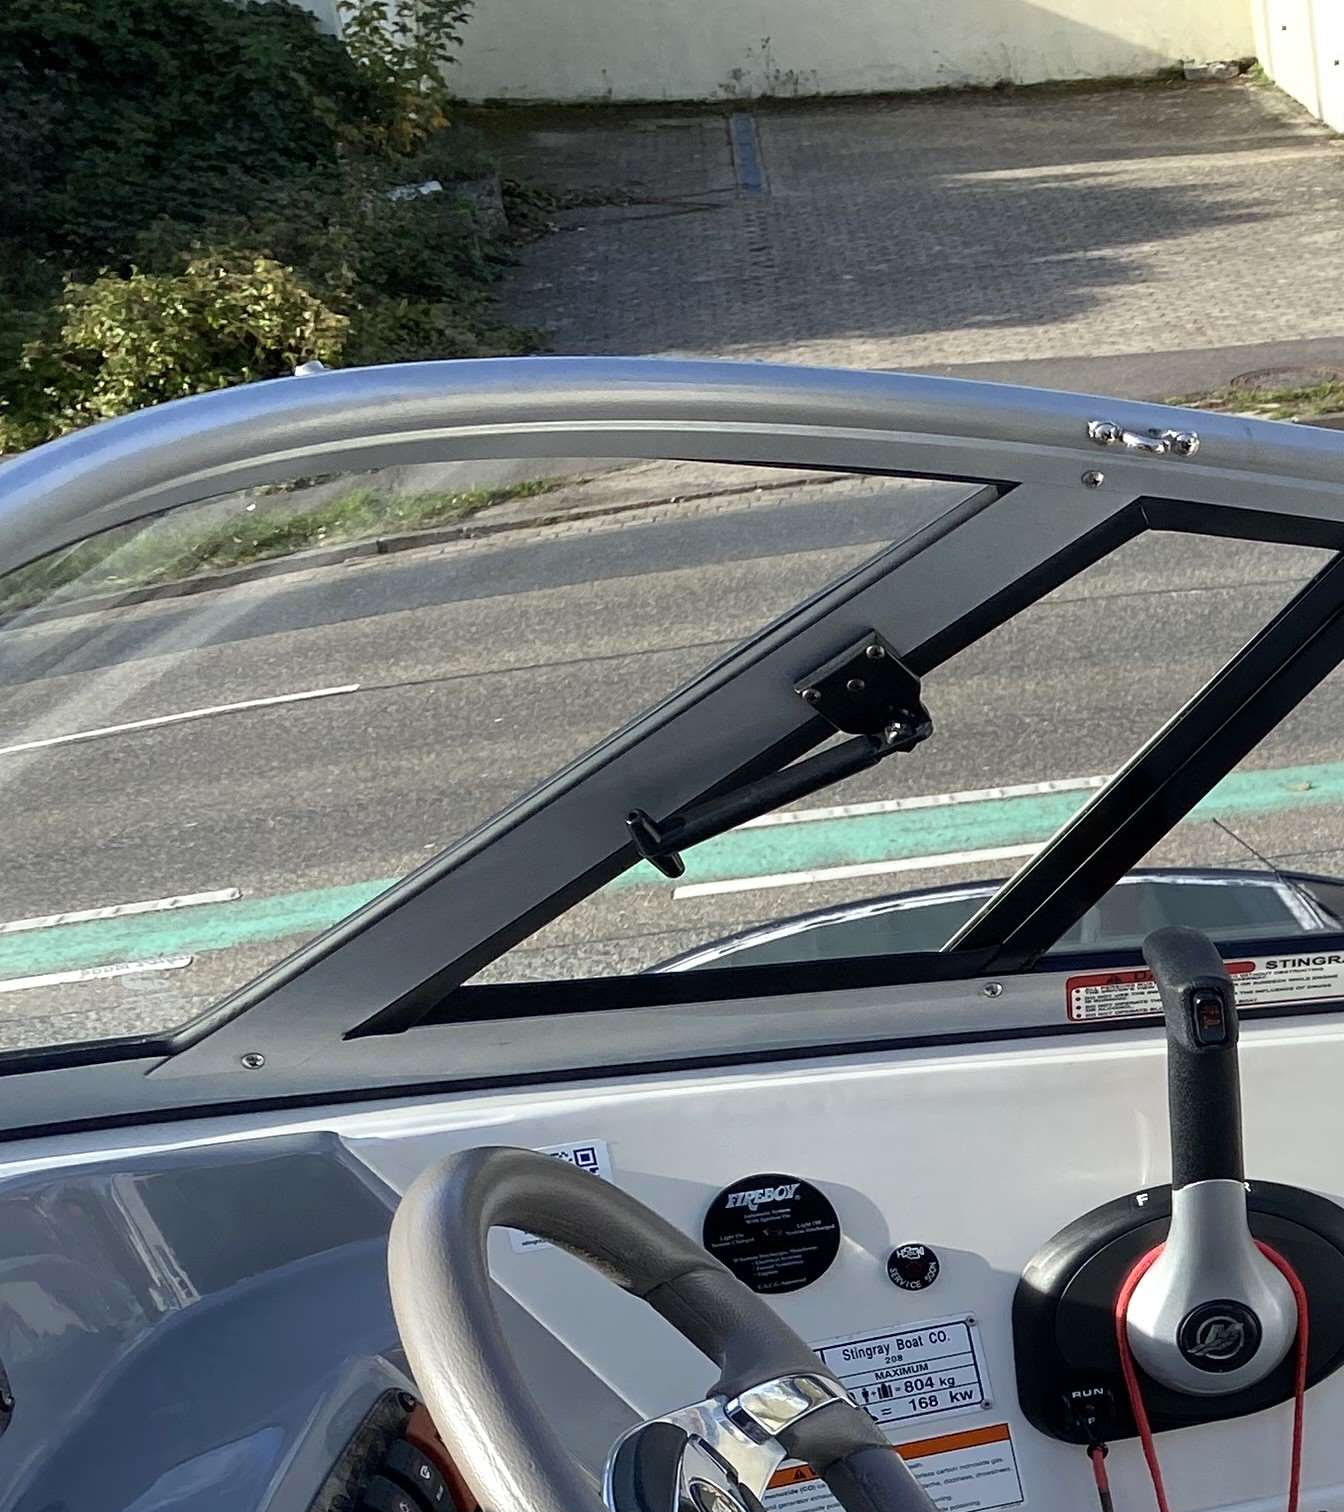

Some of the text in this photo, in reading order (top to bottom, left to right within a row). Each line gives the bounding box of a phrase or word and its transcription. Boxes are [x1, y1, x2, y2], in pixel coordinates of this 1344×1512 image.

[725, 1183, 801, 1211] FIREBOY
[1136, 1193, 1149, 1206] F
[890, 1267, 921, 1289] SERVICE
[842, 1330, 950, 1361] Stingray Boat CO.
[884, 1354, 903, 1364] 208
[875, 1363, 929, 1380] MAXIMUM
[904, 1376, 955, 1393] 804 kg
[1072, 1387, 1104, 1398] RUN
[908, 1395, 939, 1411] 168
